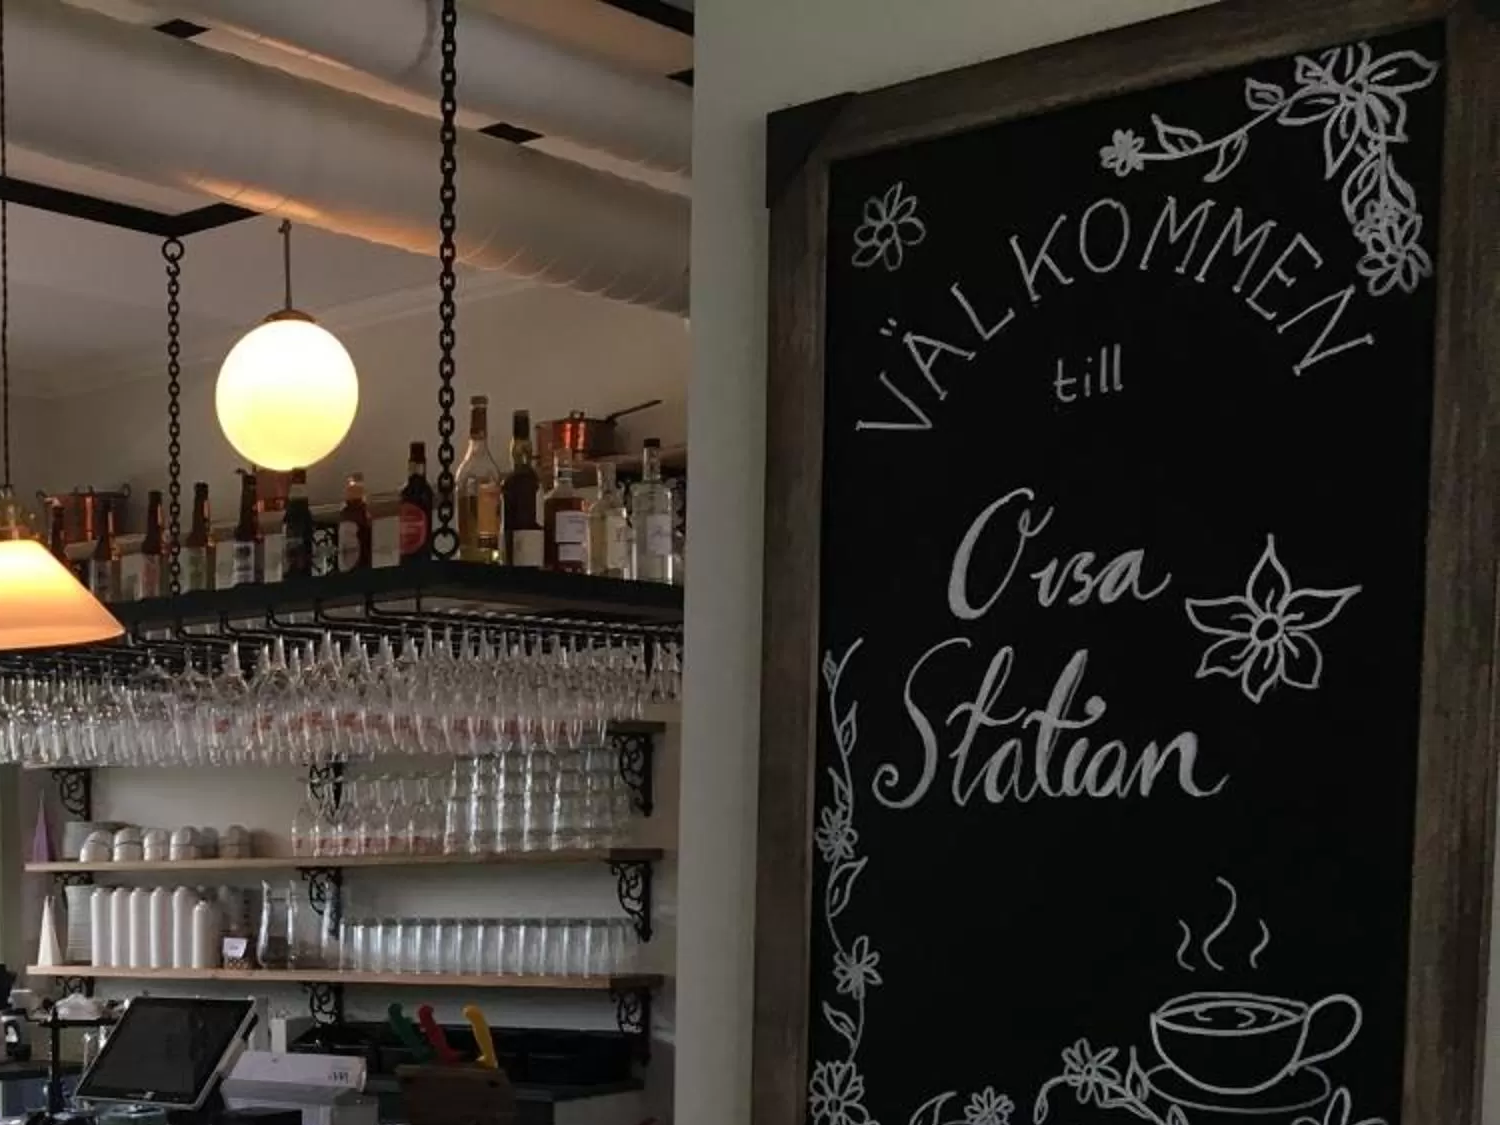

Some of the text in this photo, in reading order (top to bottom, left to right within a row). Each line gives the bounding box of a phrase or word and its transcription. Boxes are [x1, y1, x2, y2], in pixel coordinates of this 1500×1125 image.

[854, 195, 1375, 432] VÄLKOMMEN
[1052, 343, 1124, 404] till
[946, 486, 1173, 621] Orsa
[870, 636, 1230, 810] Station
